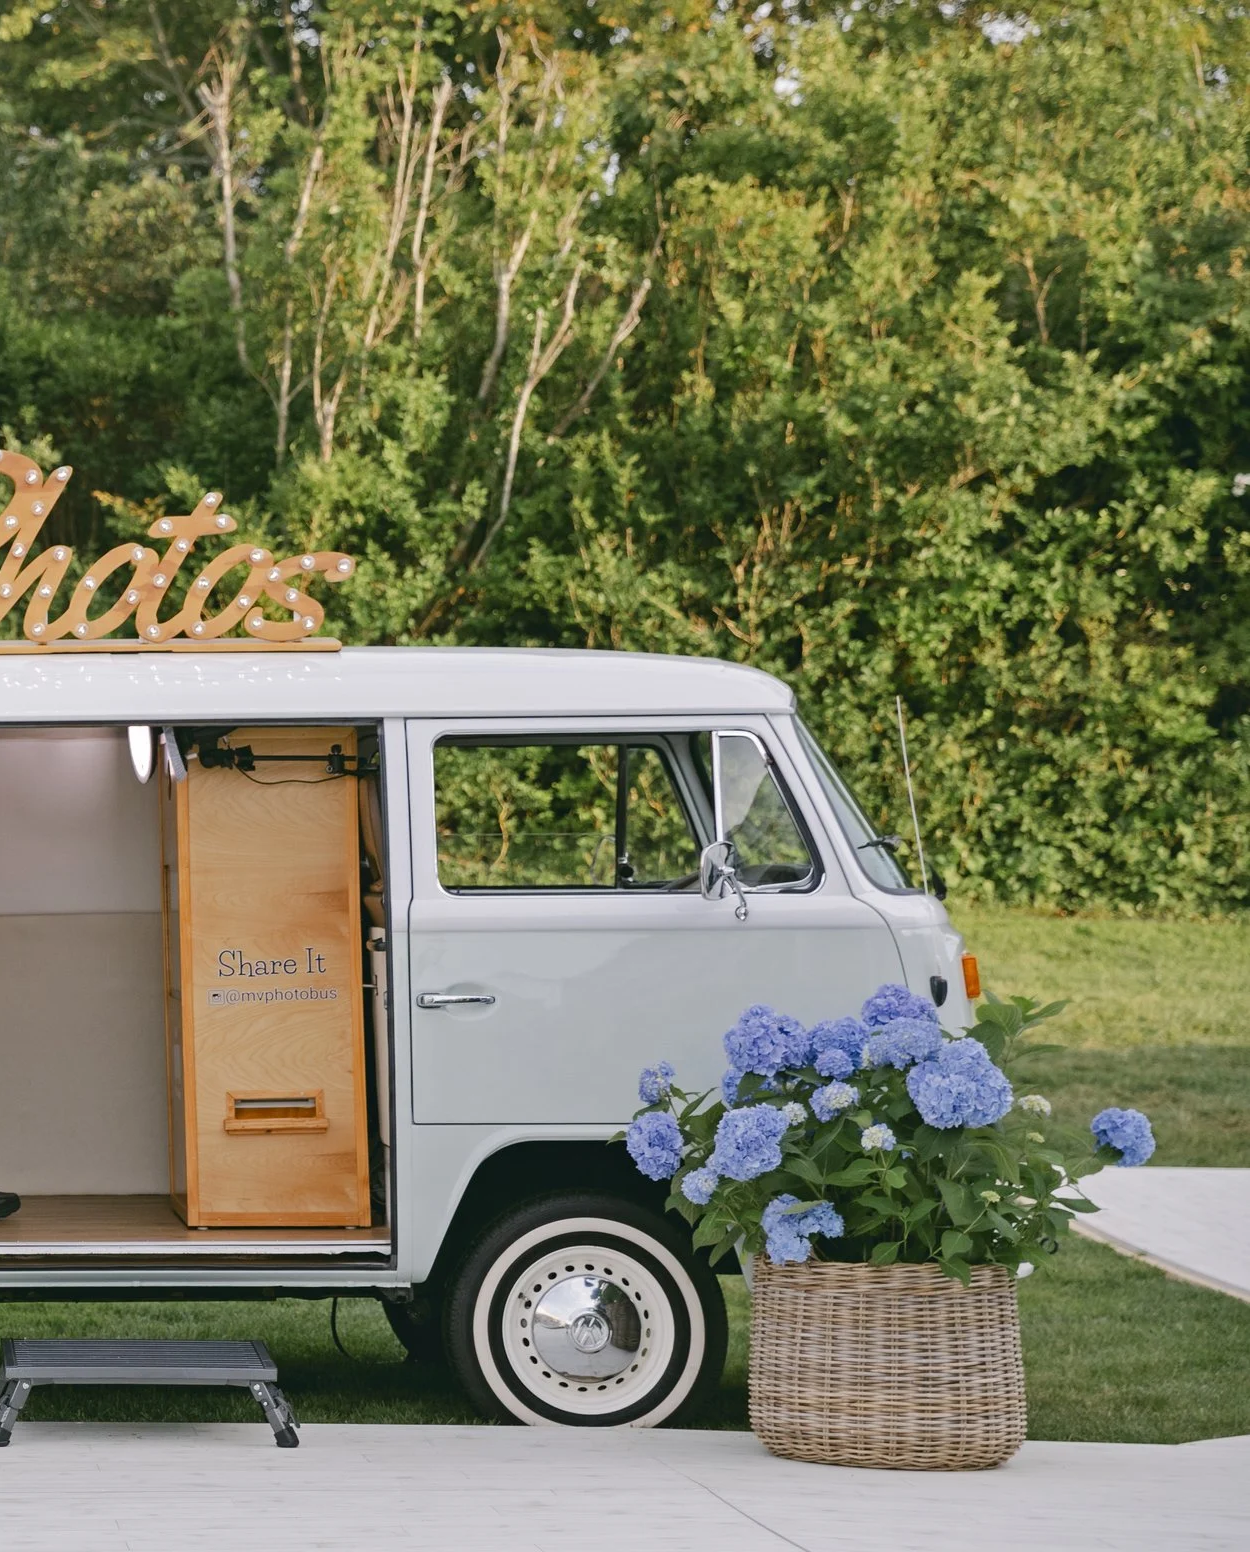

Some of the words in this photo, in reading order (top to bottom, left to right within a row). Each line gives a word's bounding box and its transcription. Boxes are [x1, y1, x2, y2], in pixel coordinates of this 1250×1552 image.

[218, 949, 298, 977] Share
[306, 947, 327, 974] It
[225, 986, 338, 1005] @mvphotobus
